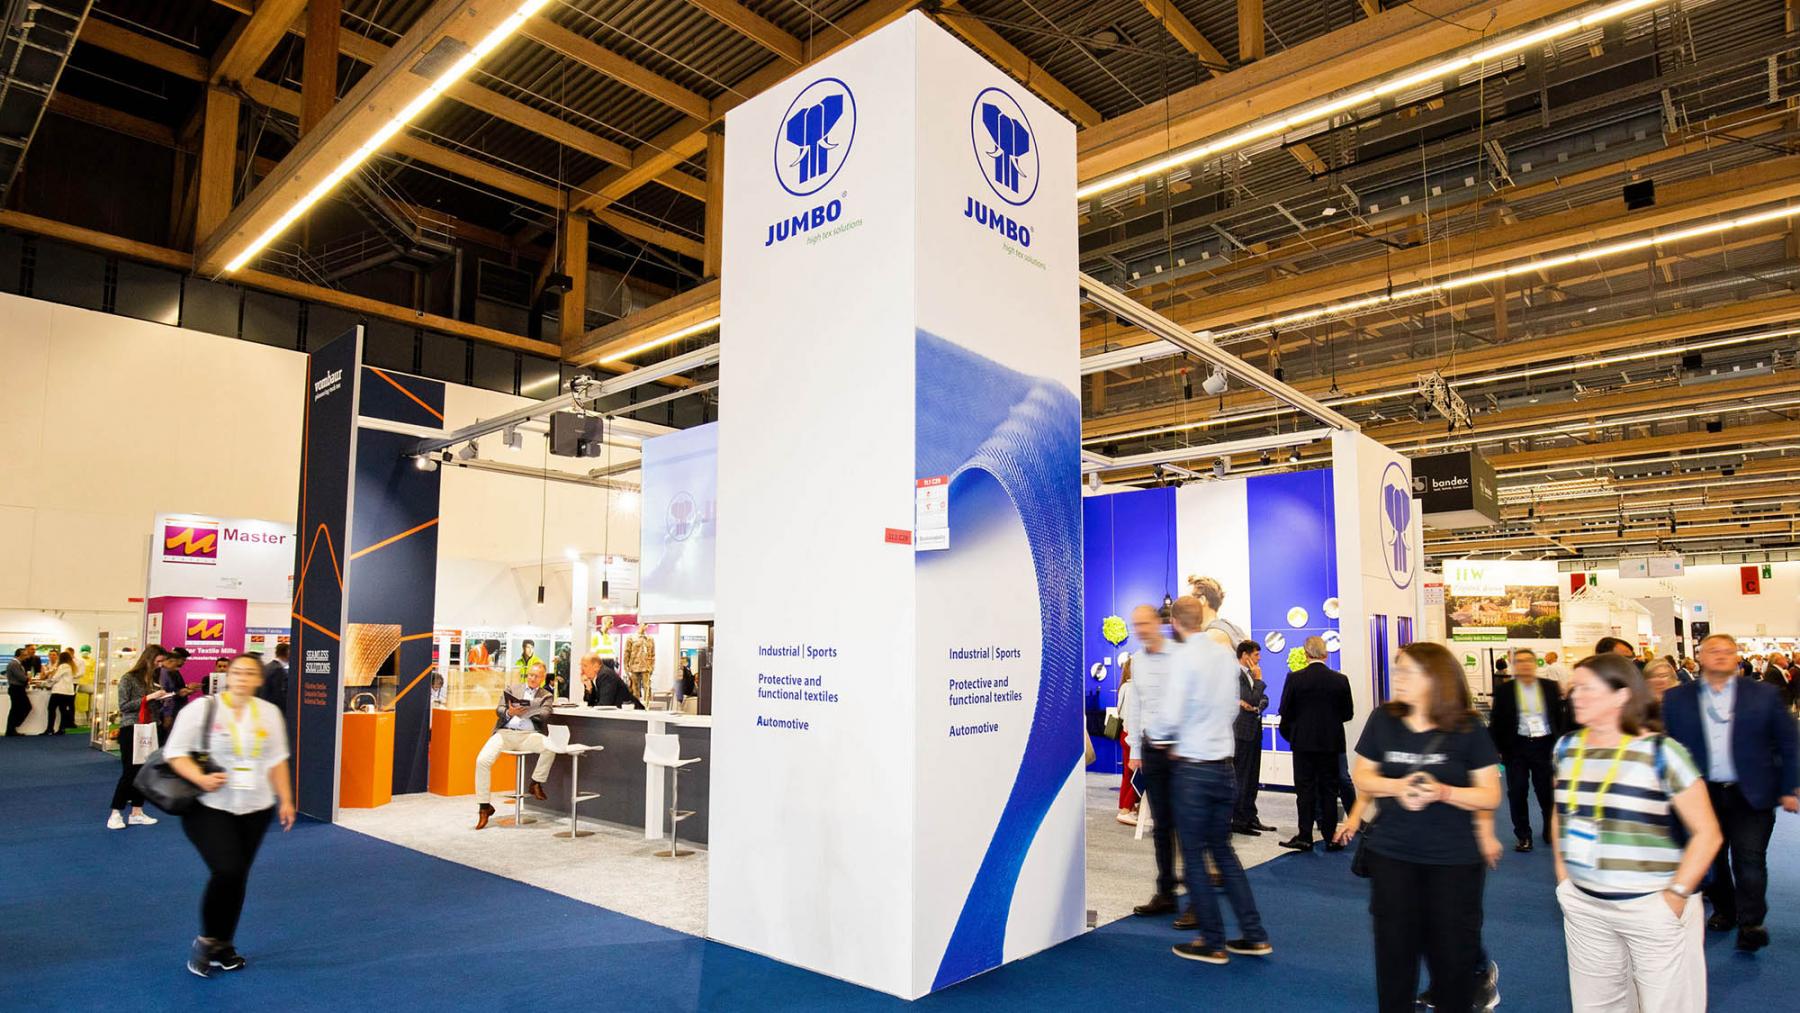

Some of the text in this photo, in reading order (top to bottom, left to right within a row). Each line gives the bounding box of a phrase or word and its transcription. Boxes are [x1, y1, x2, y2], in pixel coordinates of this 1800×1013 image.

[806, 234, 821, 245] high
[833, 219, 863, 235] solutions
[314, 368, 343, 392] vombaur
[1432, 476, 1469, 488] bandex
[223, 528, 286, 544] Master
[1745, 580, 1756, 592] C
[758, 645, 800, 657] Industrial
[806, 646, 837, 659] Sports
[949, 647, 990, 659] Industrial
[995, 647, 1021, 660] Sports
[758, 673, 822, 686] Protective and
[949, 676, 1009, 690] Protective and
[758, 687, 839, 703] functional textiles
[949, 690, 1022, 706] functional textiles
[756, 715, 809, 730] Automotive
[949, 721, 999, 737] Automotive
